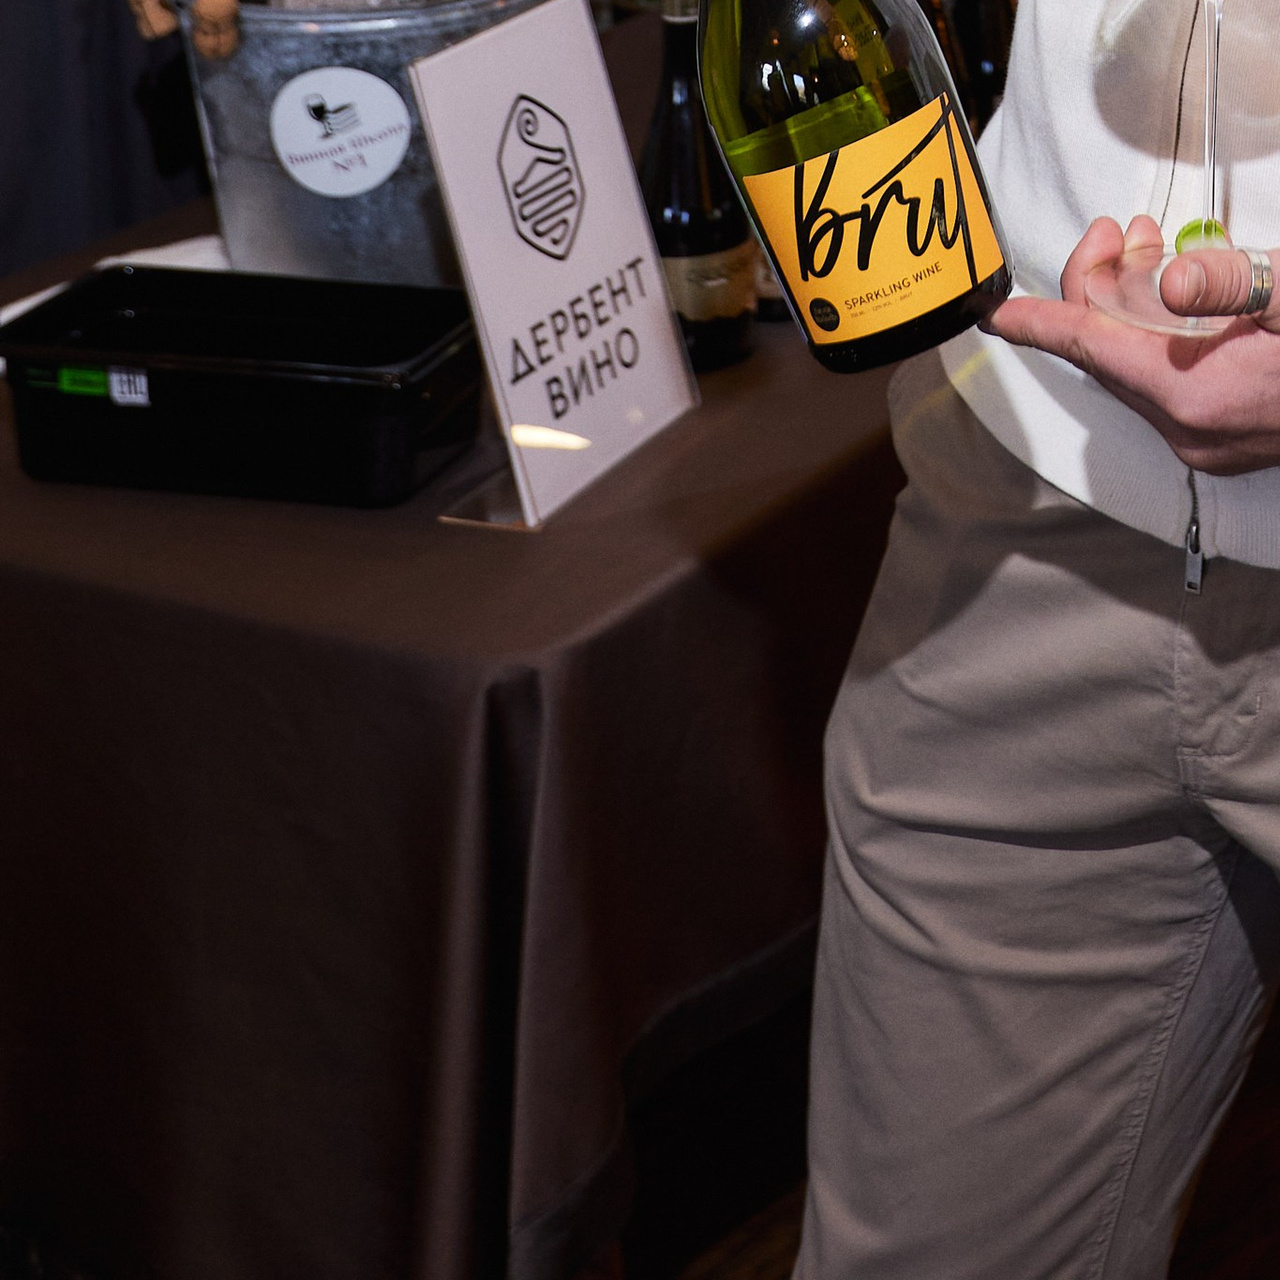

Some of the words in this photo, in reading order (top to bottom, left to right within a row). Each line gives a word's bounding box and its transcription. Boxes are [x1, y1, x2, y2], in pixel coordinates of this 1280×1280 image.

[510, 256, 647, 385] ДЕРБЕНТ
[844, 277, 911, 310] SPARKLING
[912, 261, 943, 283] WINE
[545, 327, 639, 420] ВИНО
